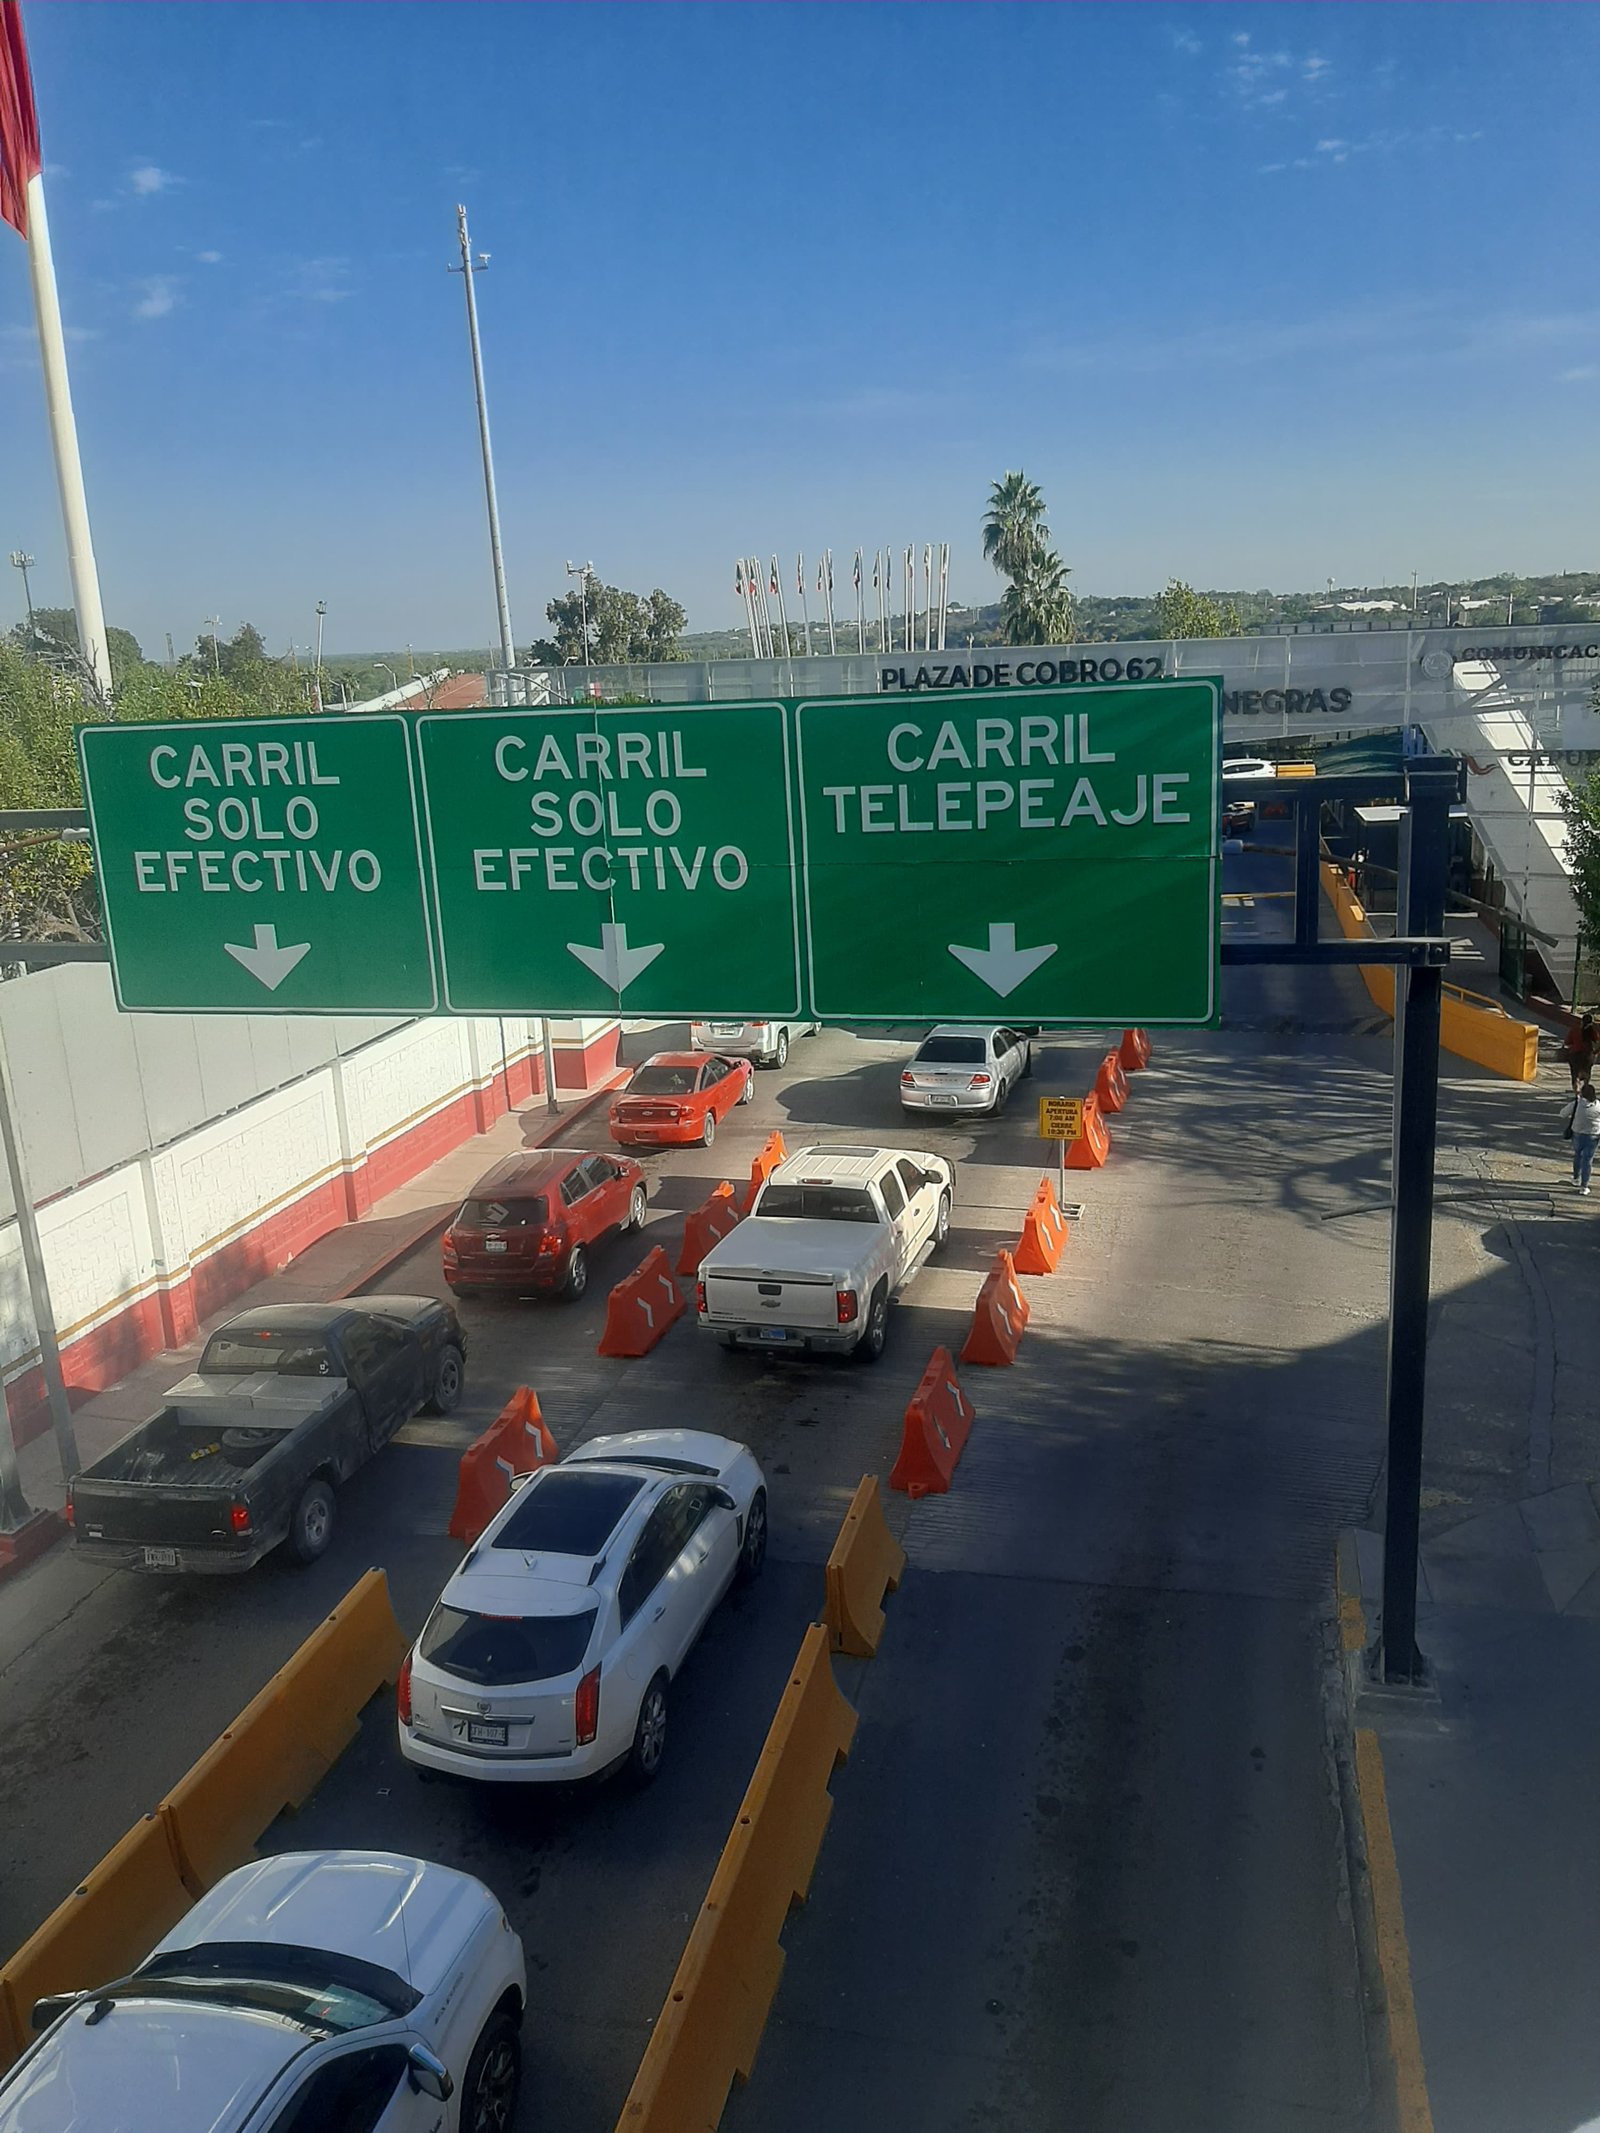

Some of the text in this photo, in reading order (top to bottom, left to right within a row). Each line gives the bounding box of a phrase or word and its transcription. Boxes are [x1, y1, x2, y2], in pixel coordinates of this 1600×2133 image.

[881, 657, 1164, 691] PLAZA DE COBRO 62
[1223, 687, 1353, 715] NEGRAS
[150, 741, 340, 789] CARRIL
[495, 731, 707, 782] CARRIL
[887, 713, 1116, 772] CARRIL
[184, 796, 320, 841] SOLO
[530, 789, 682, 838] SOLO
[823, 774, 1191, 833] TELEPEAJE
[134, 849, 382, 893] EFECTIVO
[473, 845, 749, 892] EFECTIVO
